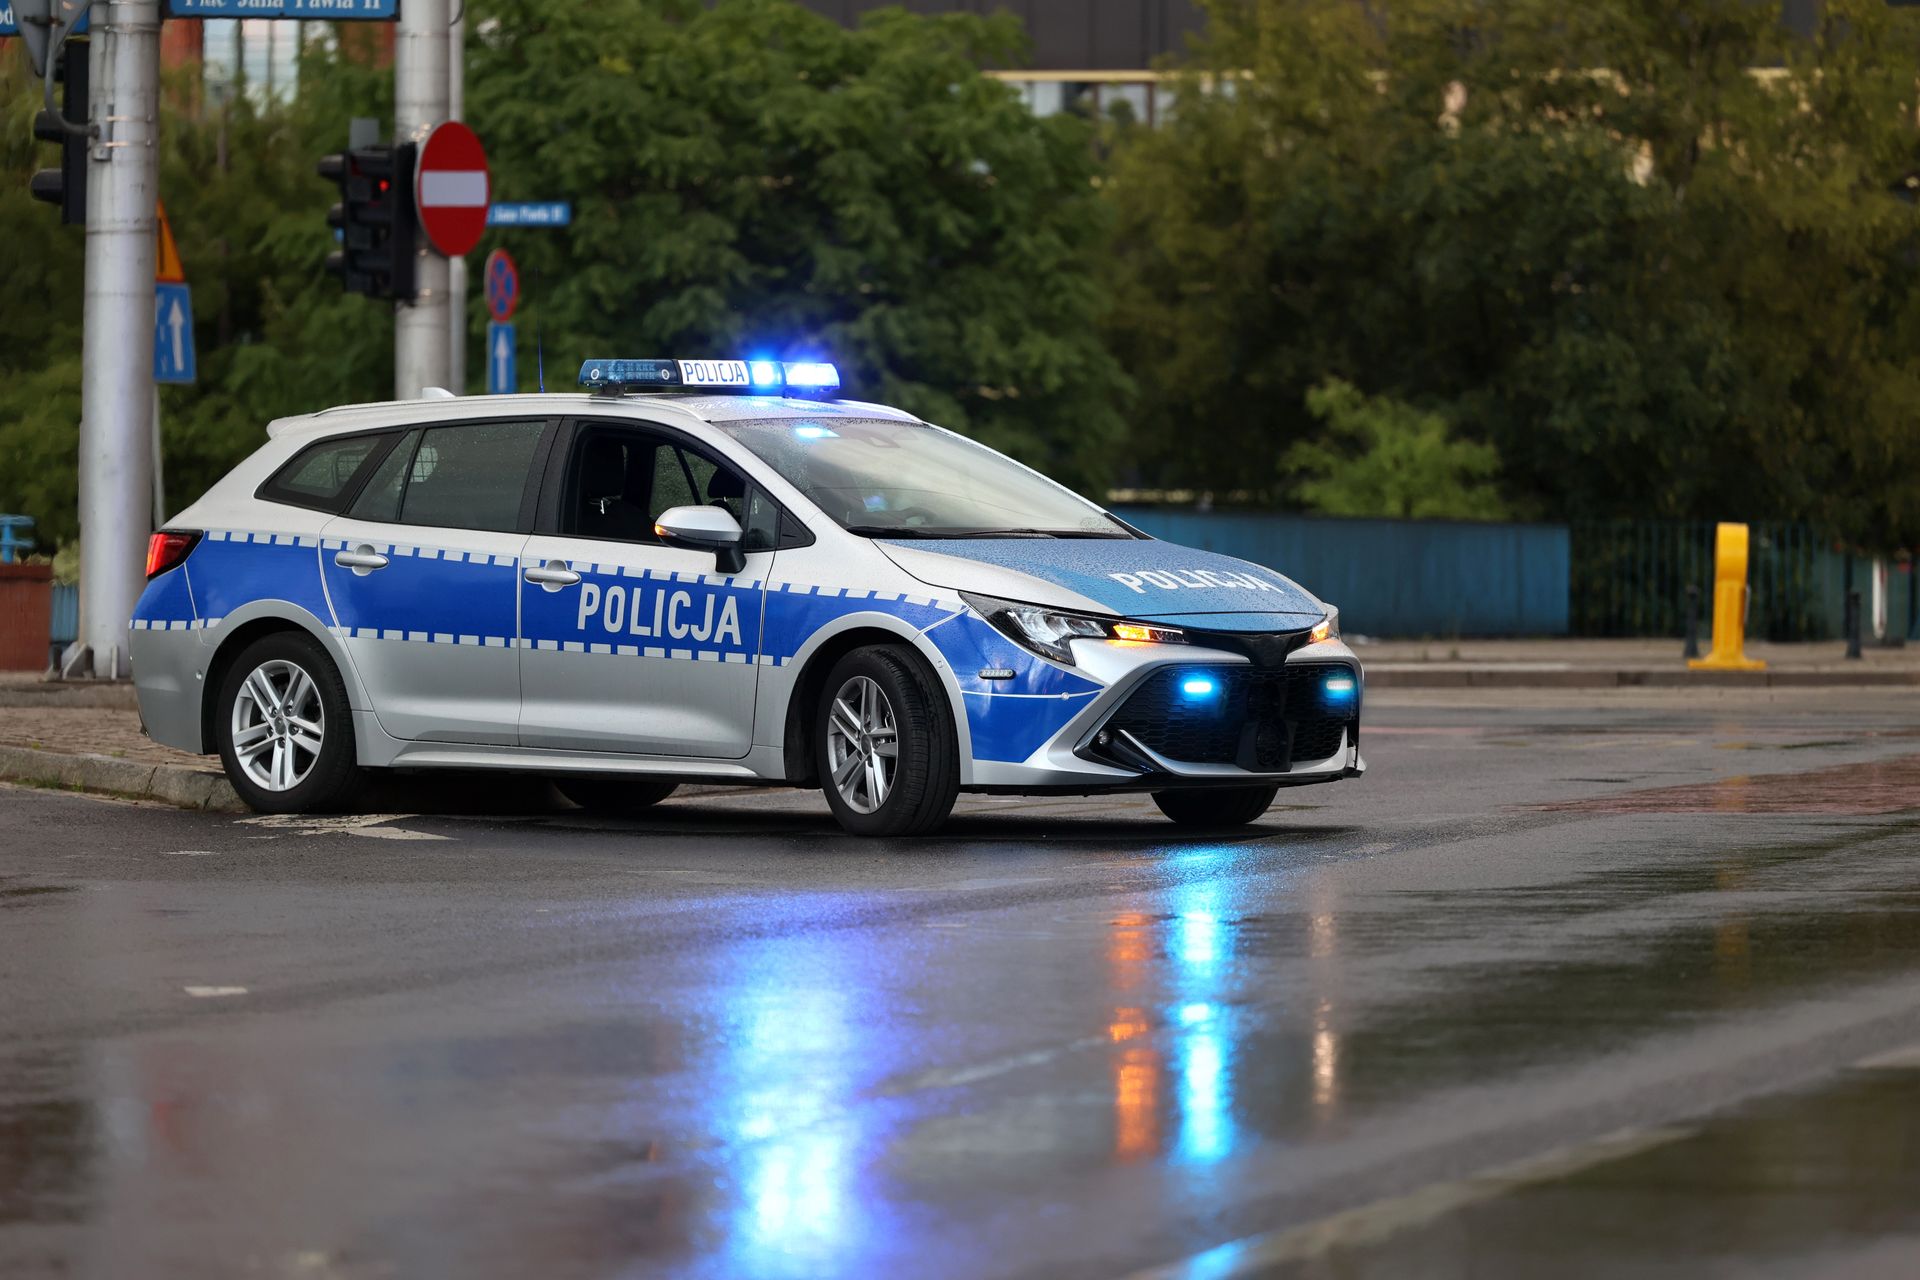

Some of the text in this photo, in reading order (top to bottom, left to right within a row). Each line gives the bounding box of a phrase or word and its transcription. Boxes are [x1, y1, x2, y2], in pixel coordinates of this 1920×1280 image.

[683, 362, 745, 382] POLICJA
[1107, 569, 1285, 594] POLICJA
[577, 582, 742, 646] POLICJA
